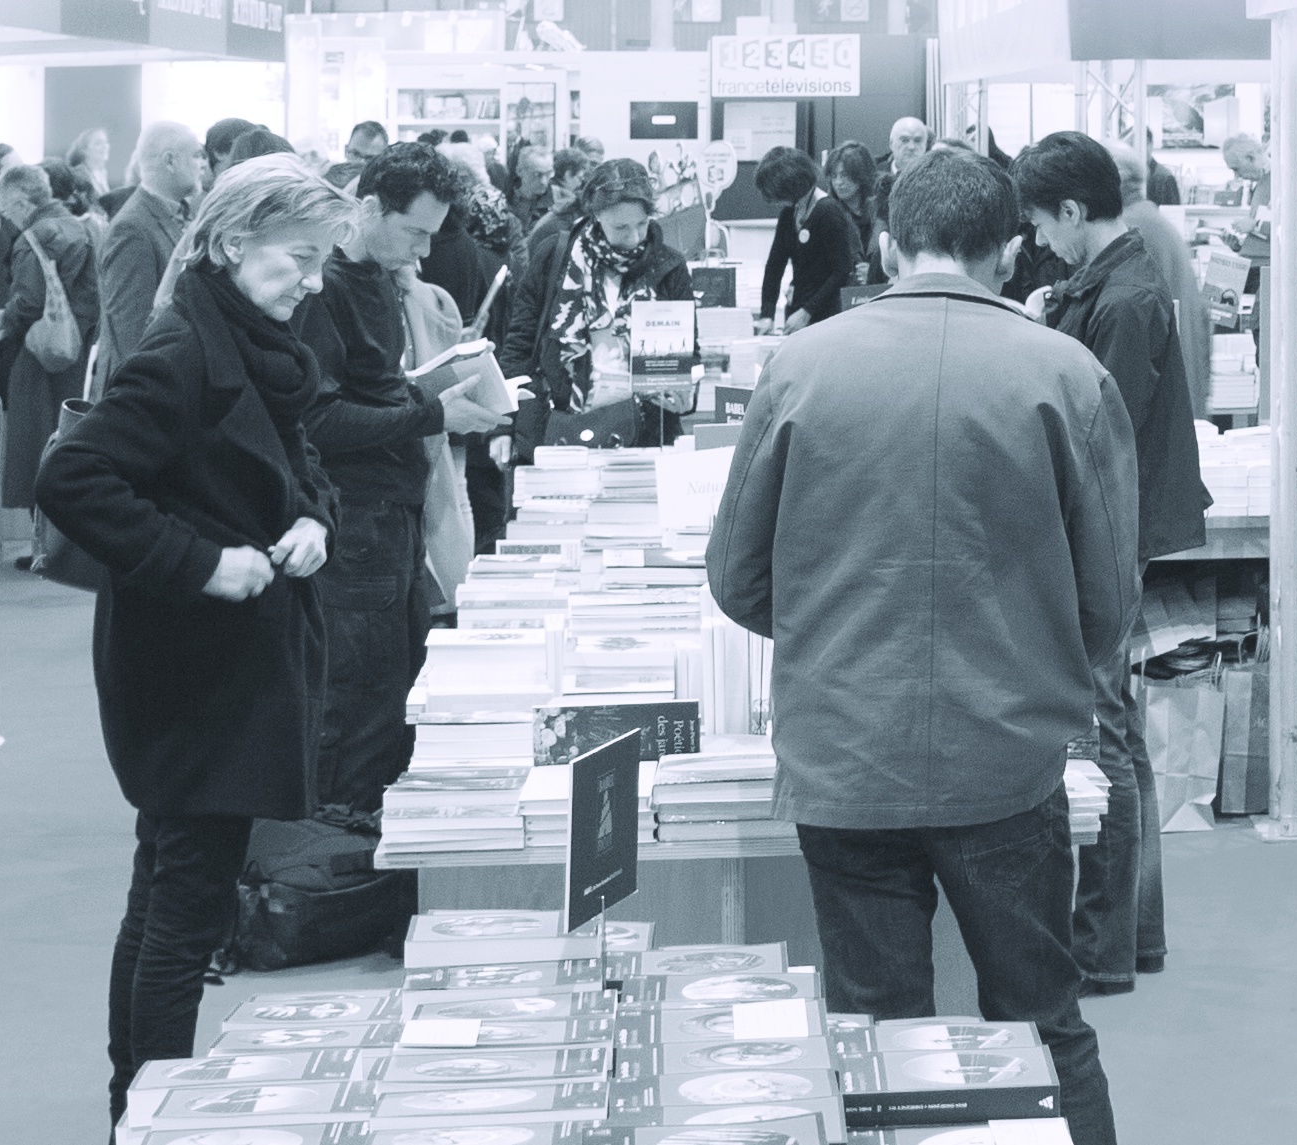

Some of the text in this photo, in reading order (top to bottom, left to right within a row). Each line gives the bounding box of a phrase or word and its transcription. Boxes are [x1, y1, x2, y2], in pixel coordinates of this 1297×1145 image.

[717, 78, 852, 93] francetélévisions
[687, 482, 725, 495] Natur
[657, 715, 669, 736] des
